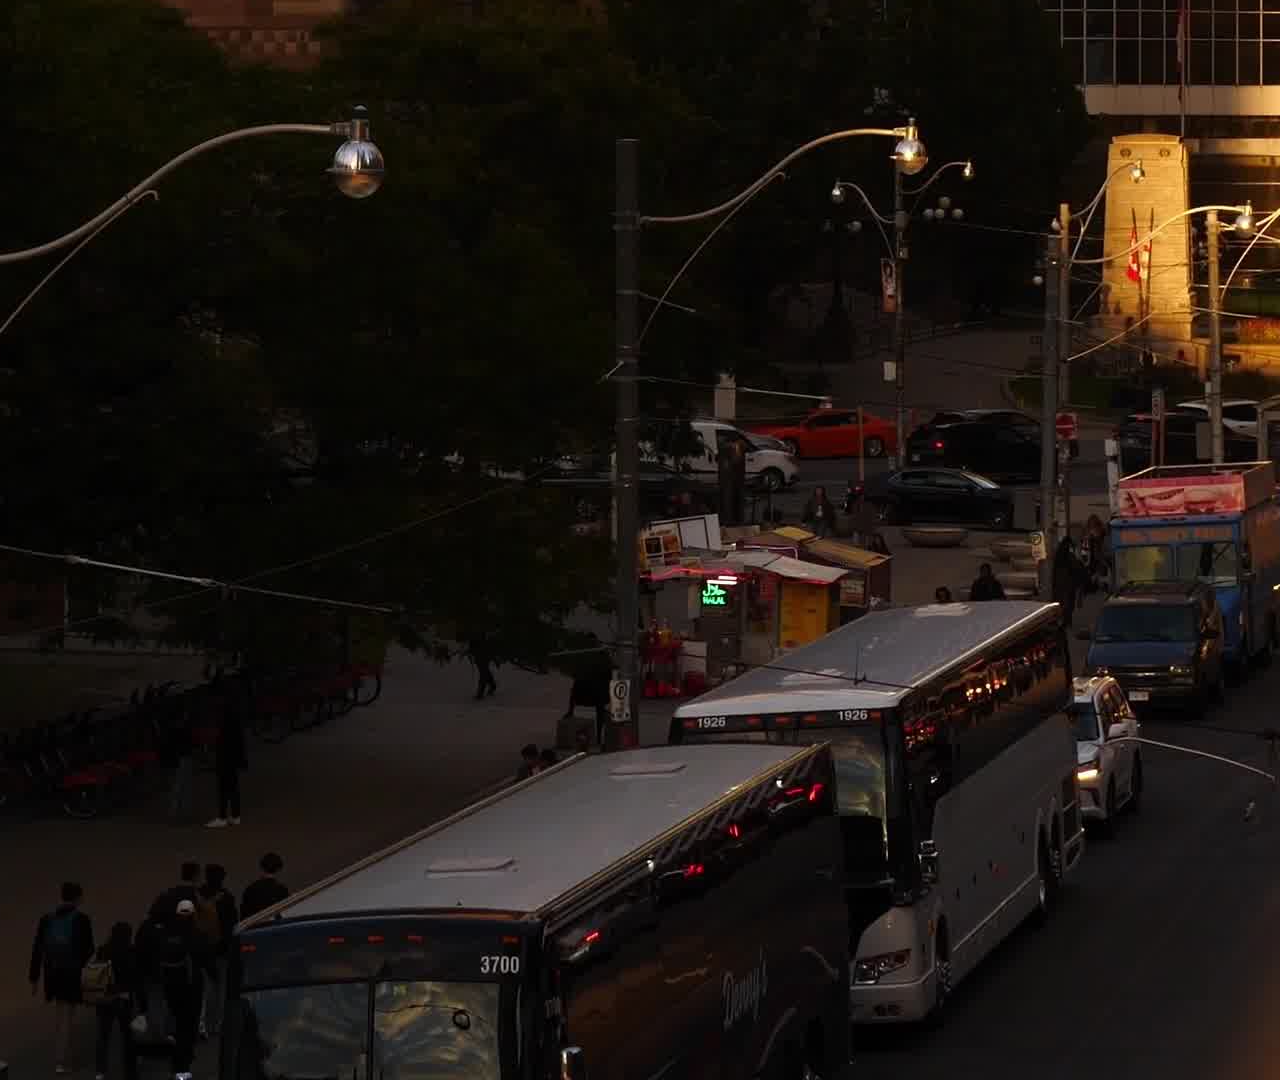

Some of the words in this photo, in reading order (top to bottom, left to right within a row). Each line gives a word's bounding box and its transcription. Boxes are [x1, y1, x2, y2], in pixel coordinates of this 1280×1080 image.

[840, 710, 868, 720] 1926
[697, 717, 726, 728] 1926
[480, 956, 520, 974] 3700
